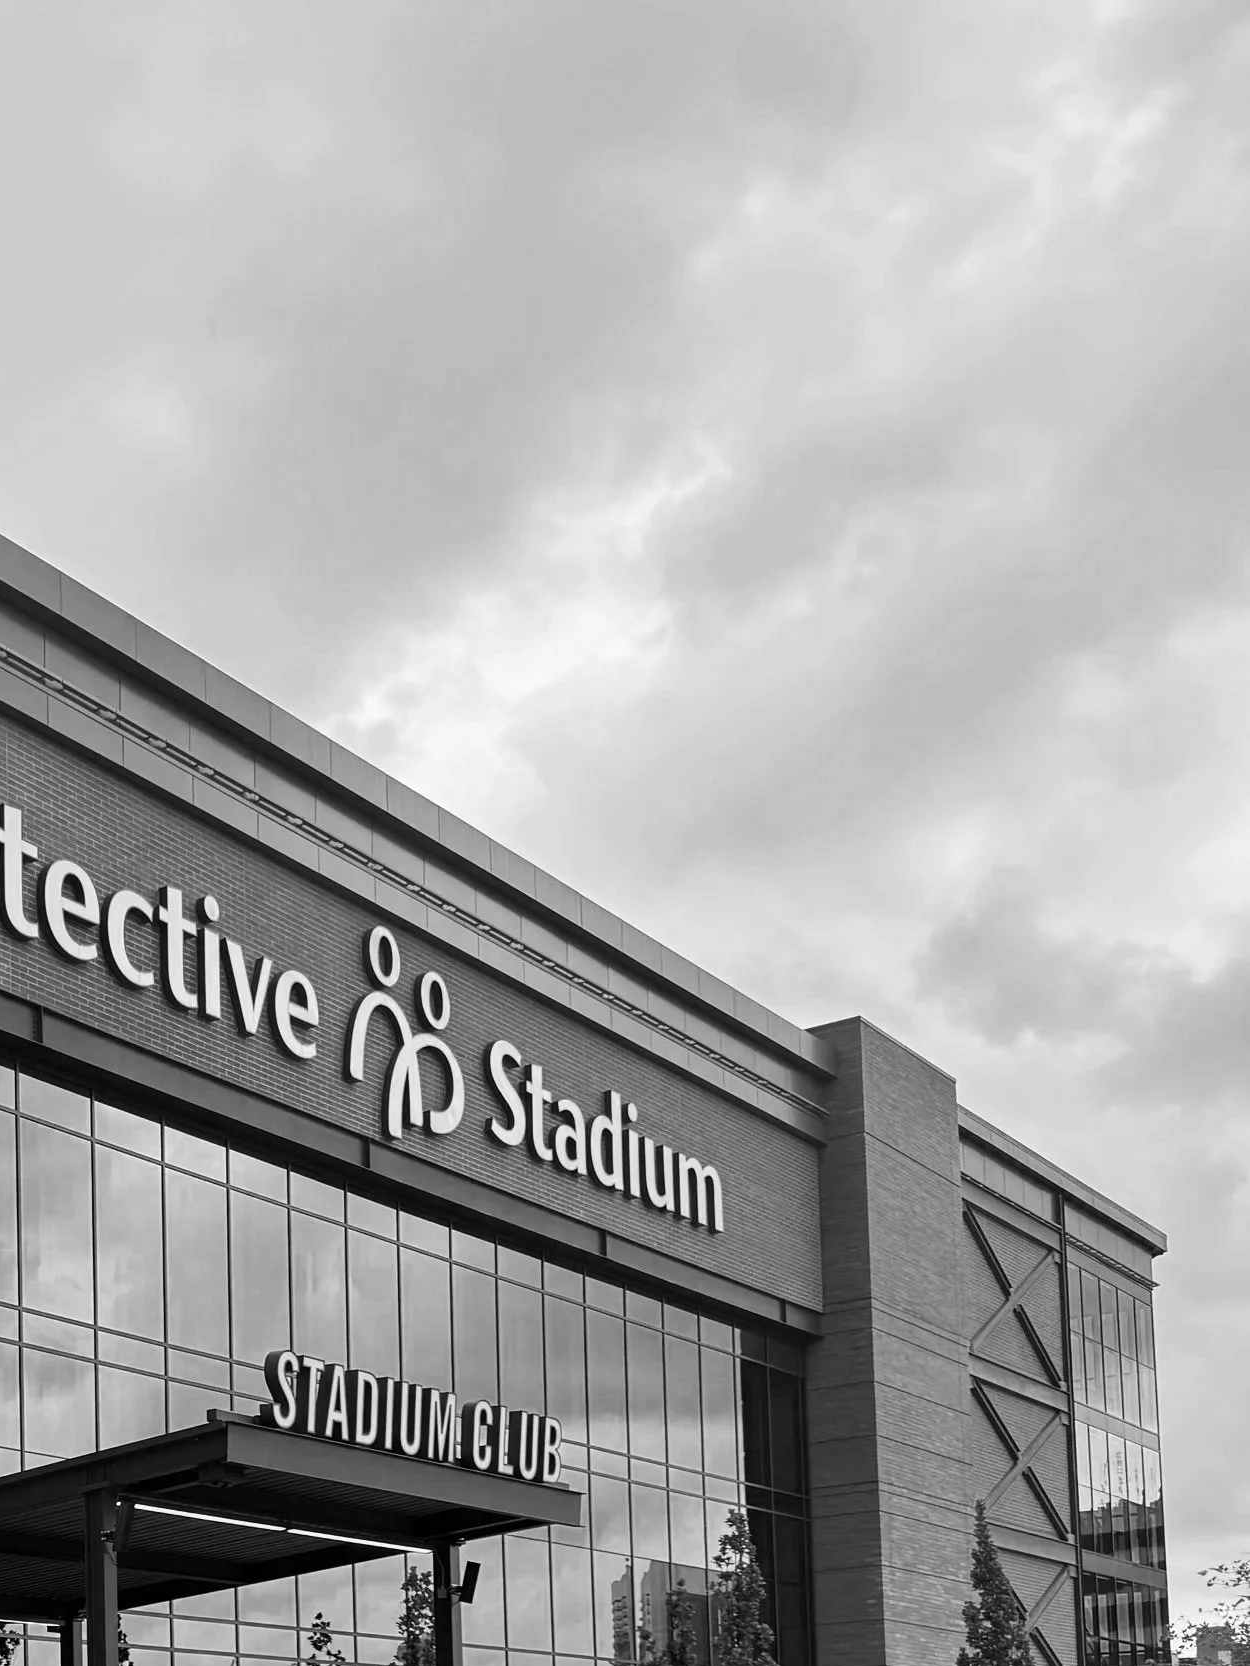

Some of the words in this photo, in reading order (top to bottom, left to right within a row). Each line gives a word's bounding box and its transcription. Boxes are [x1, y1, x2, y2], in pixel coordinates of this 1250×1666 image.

[486, 1039, 724, 1233] Stadium
[266, 1350, 457, 1464] STADIUM
[464, 1400, 562, 1483] CLUB
